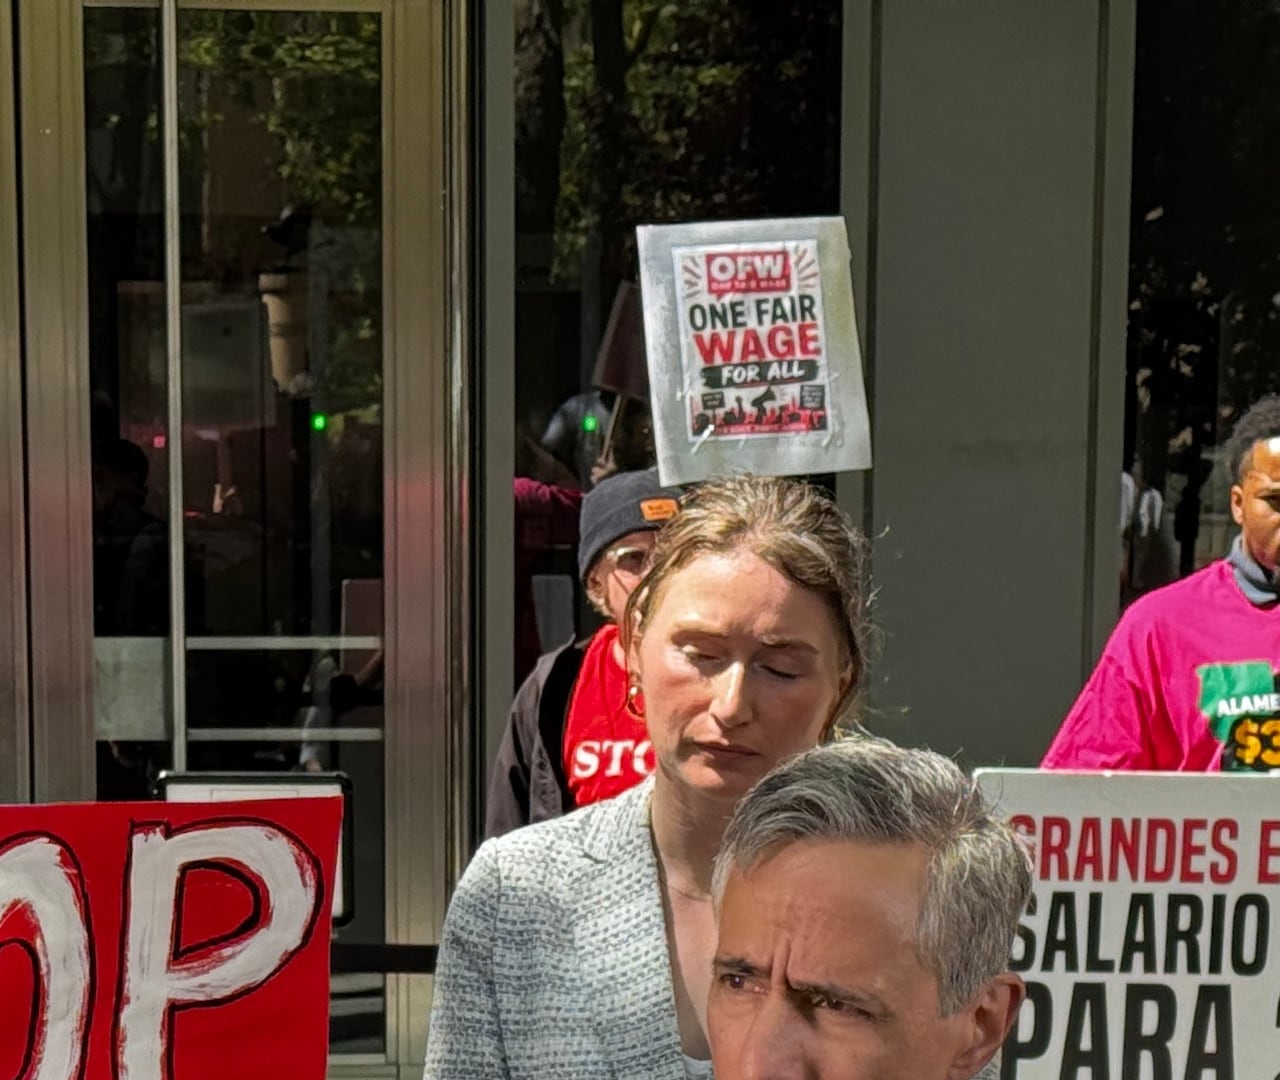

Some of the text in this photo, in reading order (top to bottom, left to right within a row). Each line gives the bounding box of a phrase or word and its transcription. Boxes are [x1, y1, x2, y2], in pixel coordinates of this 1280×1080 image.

[710, 254, 784, 281] OFW
[689, 294, 817, 332] ONE FAIR
[693, 323, 822, 365] WAGE
[721, 360, 805, 386] FOR ALL
[1008, 890, 1268, 976] SALARIO
